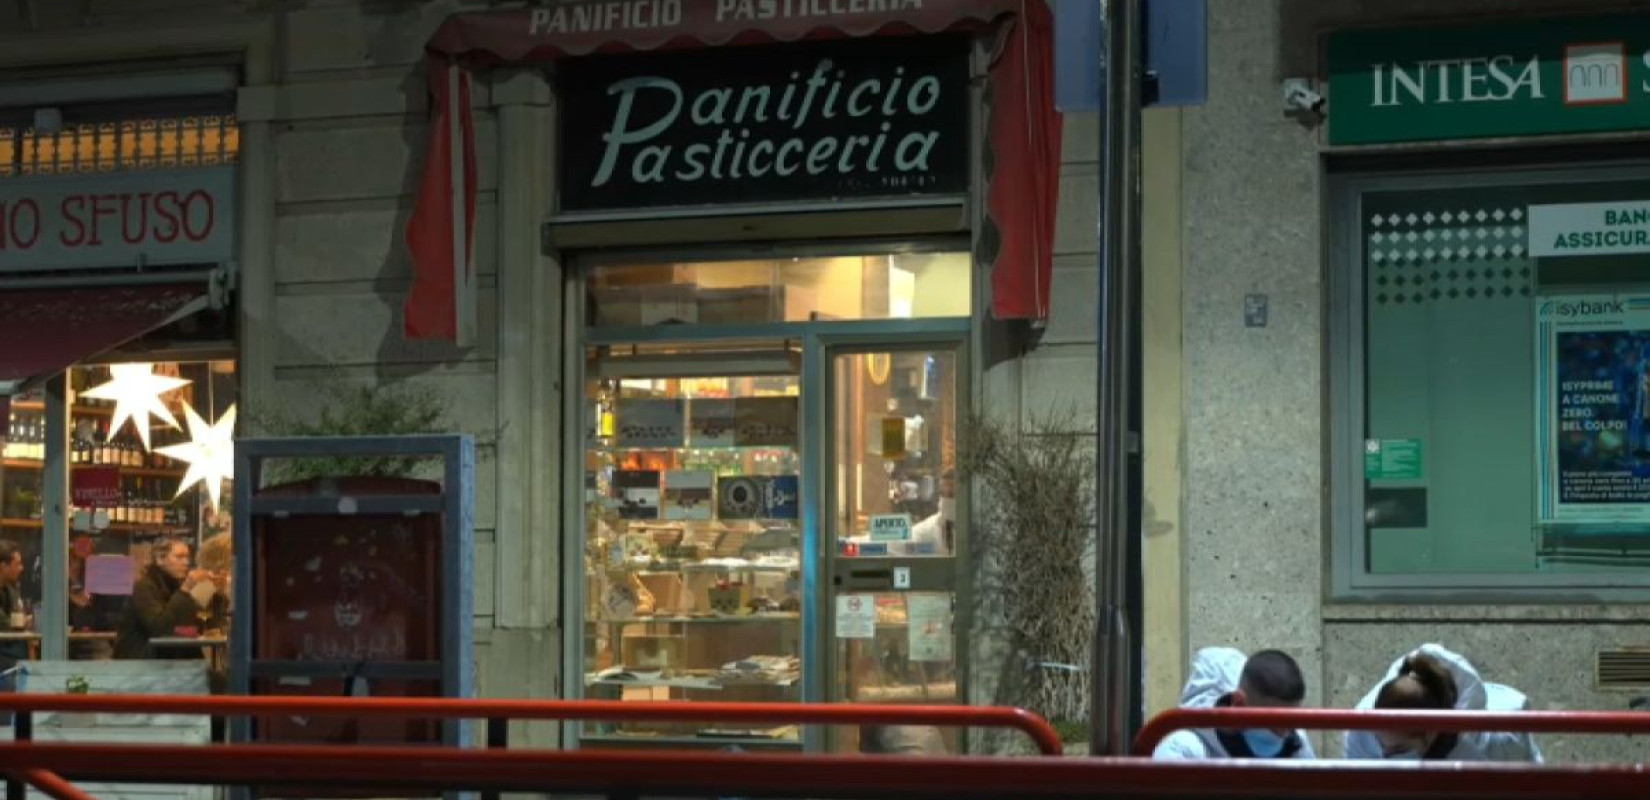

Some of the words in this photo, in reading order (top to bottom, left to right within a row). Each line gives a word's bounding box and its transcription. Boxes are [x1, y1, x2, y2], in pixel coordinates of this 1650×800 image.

[529, 0, 682, 35] PANIFICIO
[1370, 54, 1546, 107] INTESA
[602, 57, 941, 142] Panificio
[0, 197, 40, 249] O
[59, 188, 214, 247] SFUSO
[1604, 208, 1650, 226] BAN
[1553, 229, 1650, 249] ASSICUR
[1556, 300, 1624, 317] isybank
[1562, 394, 1570, 404] A
[1573, 393, 1620, 404] CANONE
[1562, 421, 1581, 431] BEL
